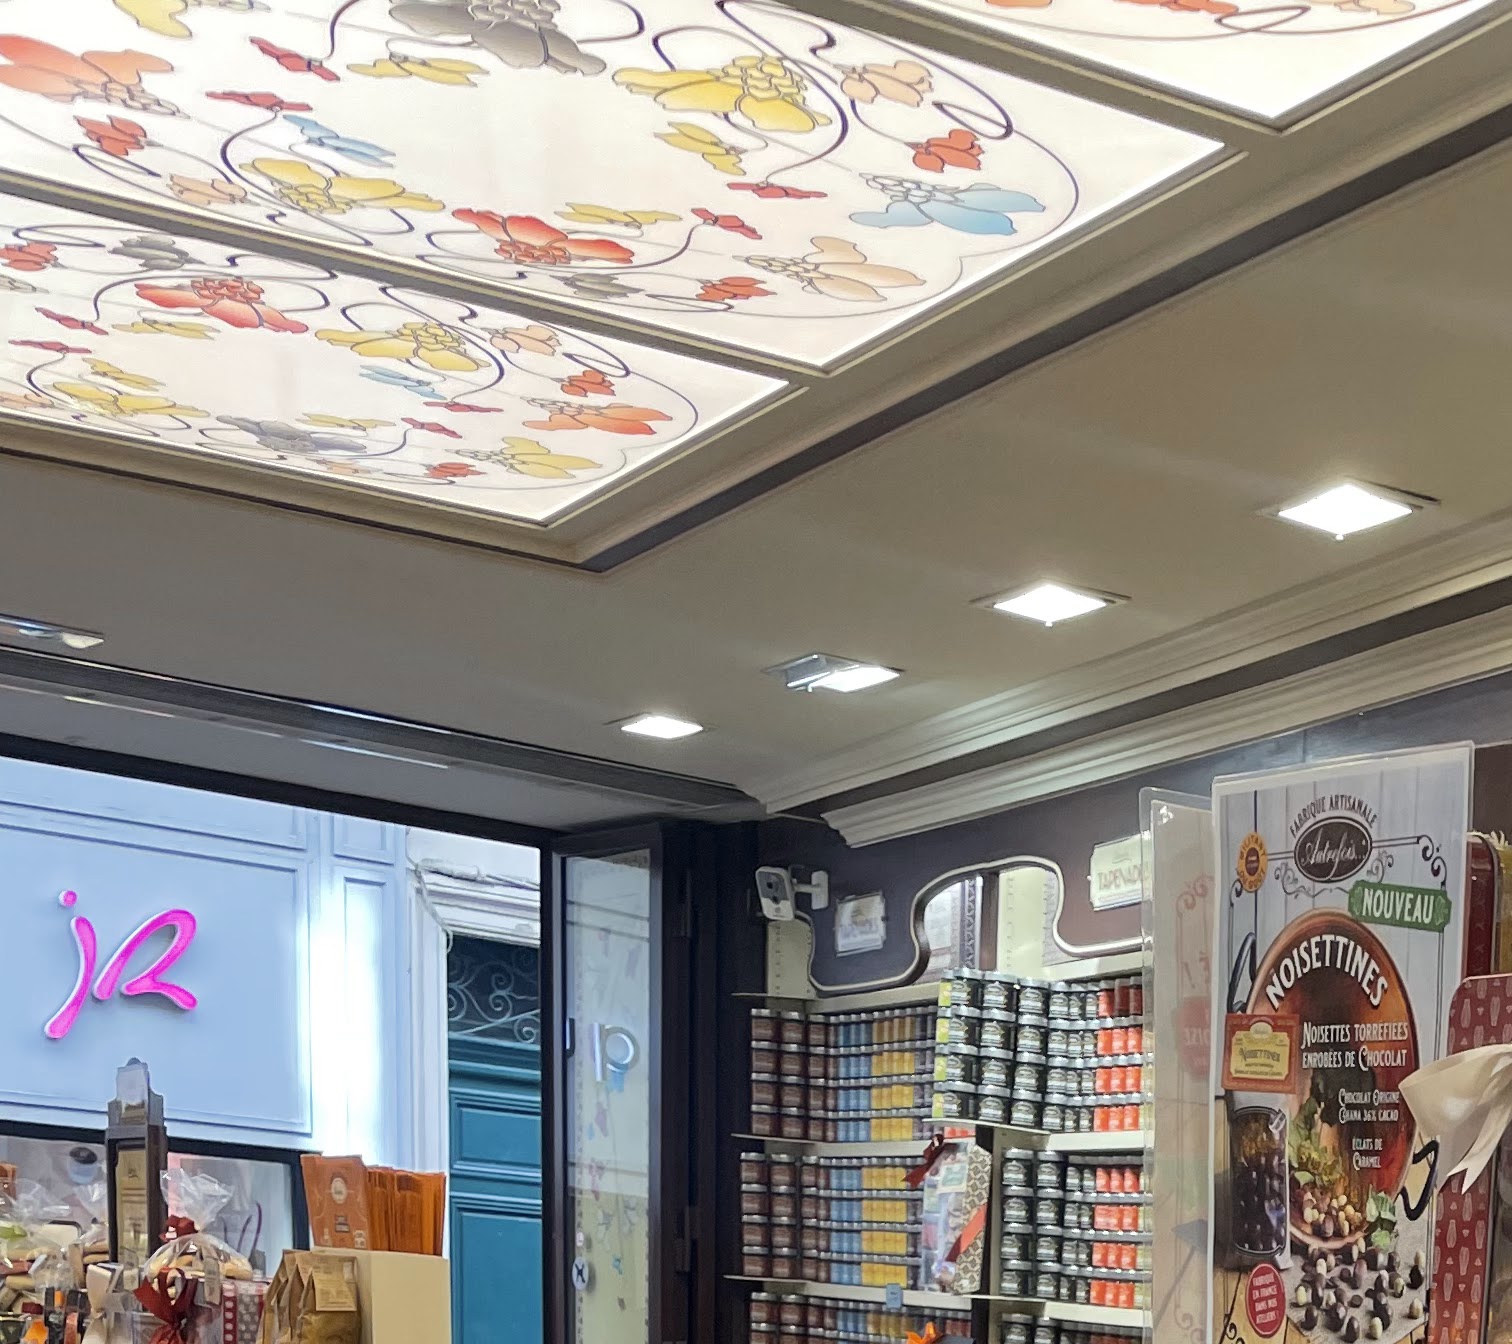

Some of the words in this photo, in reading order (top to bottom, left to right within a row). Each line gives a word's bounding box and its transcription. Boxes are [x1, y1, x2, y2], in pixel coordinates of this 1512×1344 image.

[1290, 796, 1326, 838] FABRIQUE
[1329, 795, 1377, 828] ARTISANALE
[1362, 888, 1435, 924] NOUVEAU
[1266, 934, 1389, 1011] NOISETTINES
[1301, 1021, 1350, 1049] NOISETTES
[1344, 1051, 1356, 1067] DE
[1358, 1045, 1407, 1071] CHOCOLAT
[1378, 1108, 1399, 1122] CACAO
